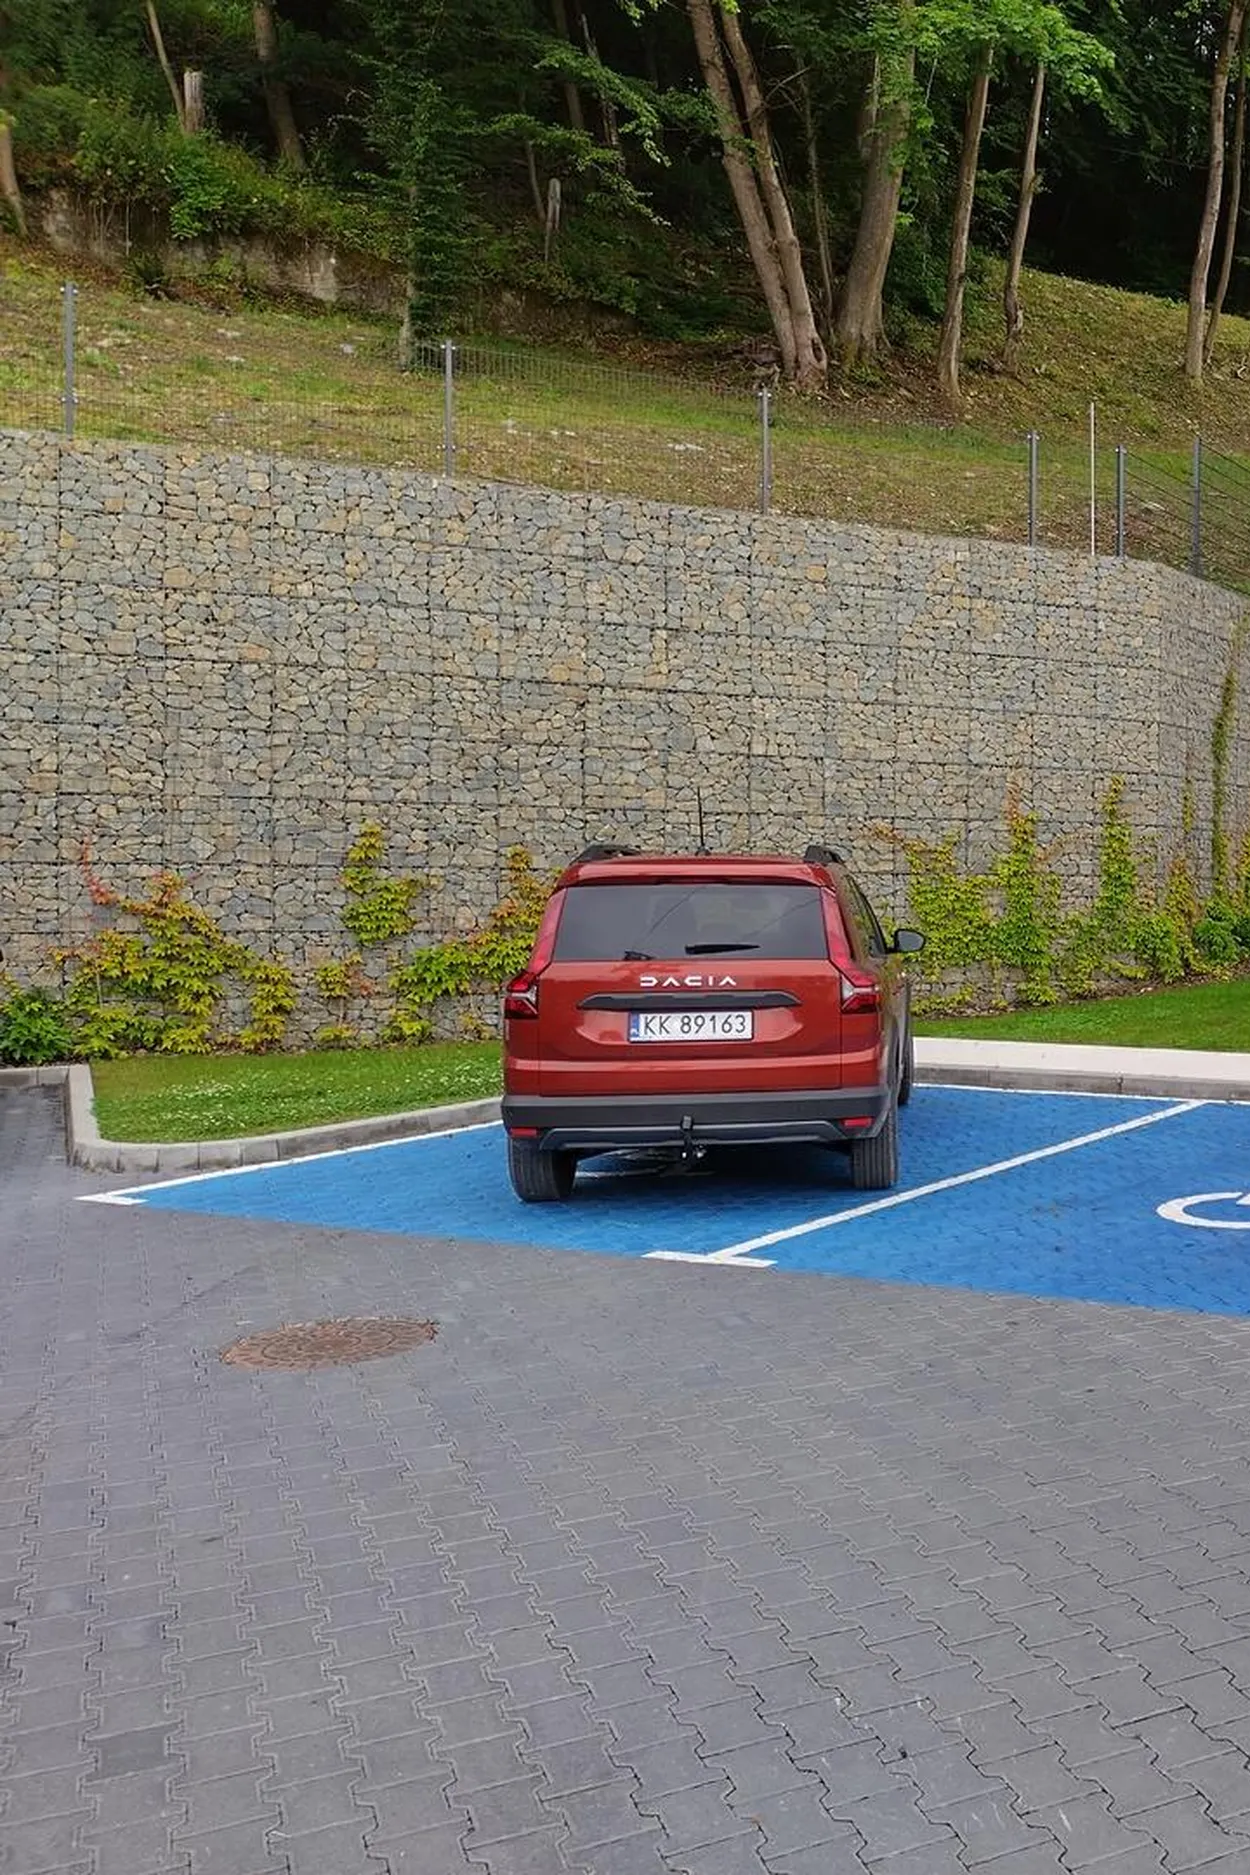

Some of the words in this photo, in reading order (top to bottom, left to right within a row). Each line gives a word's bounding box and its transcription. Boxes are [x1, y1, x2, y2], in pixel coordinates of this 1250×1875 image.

[640, 976, 736, 986] DACIA
[644, 1015, 671, 1035] KK
[680, 1014, 746, 1034] 89163
